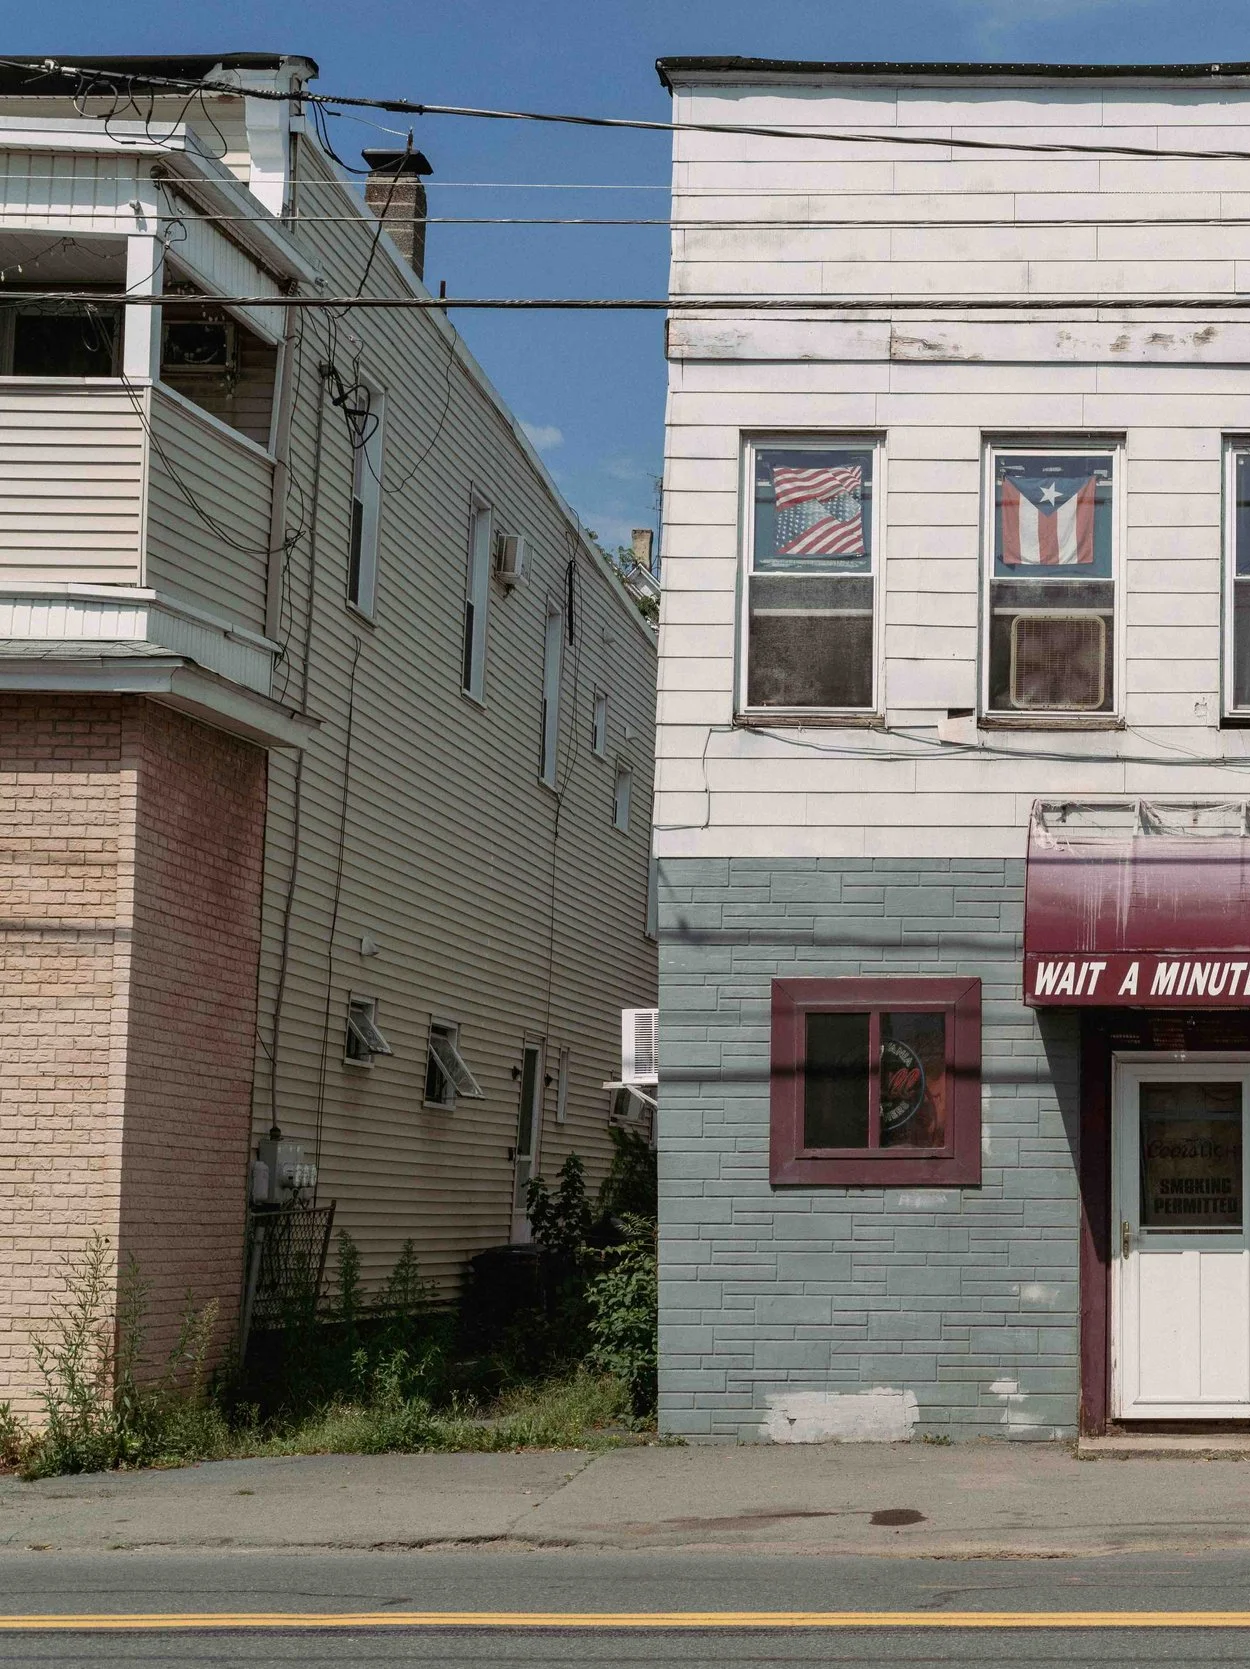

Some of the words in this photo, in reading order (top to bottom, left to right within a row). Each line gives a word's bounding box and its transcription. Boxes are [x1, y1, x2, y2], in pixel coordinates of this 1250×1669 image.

[1034, 961, 1107, 996] WAIT
[1118, 961, 1140, 996] A
[1159, 1177, 1232, 1194] SMOKING
[1154, 1197, 1238, 1214] PERMITTED
